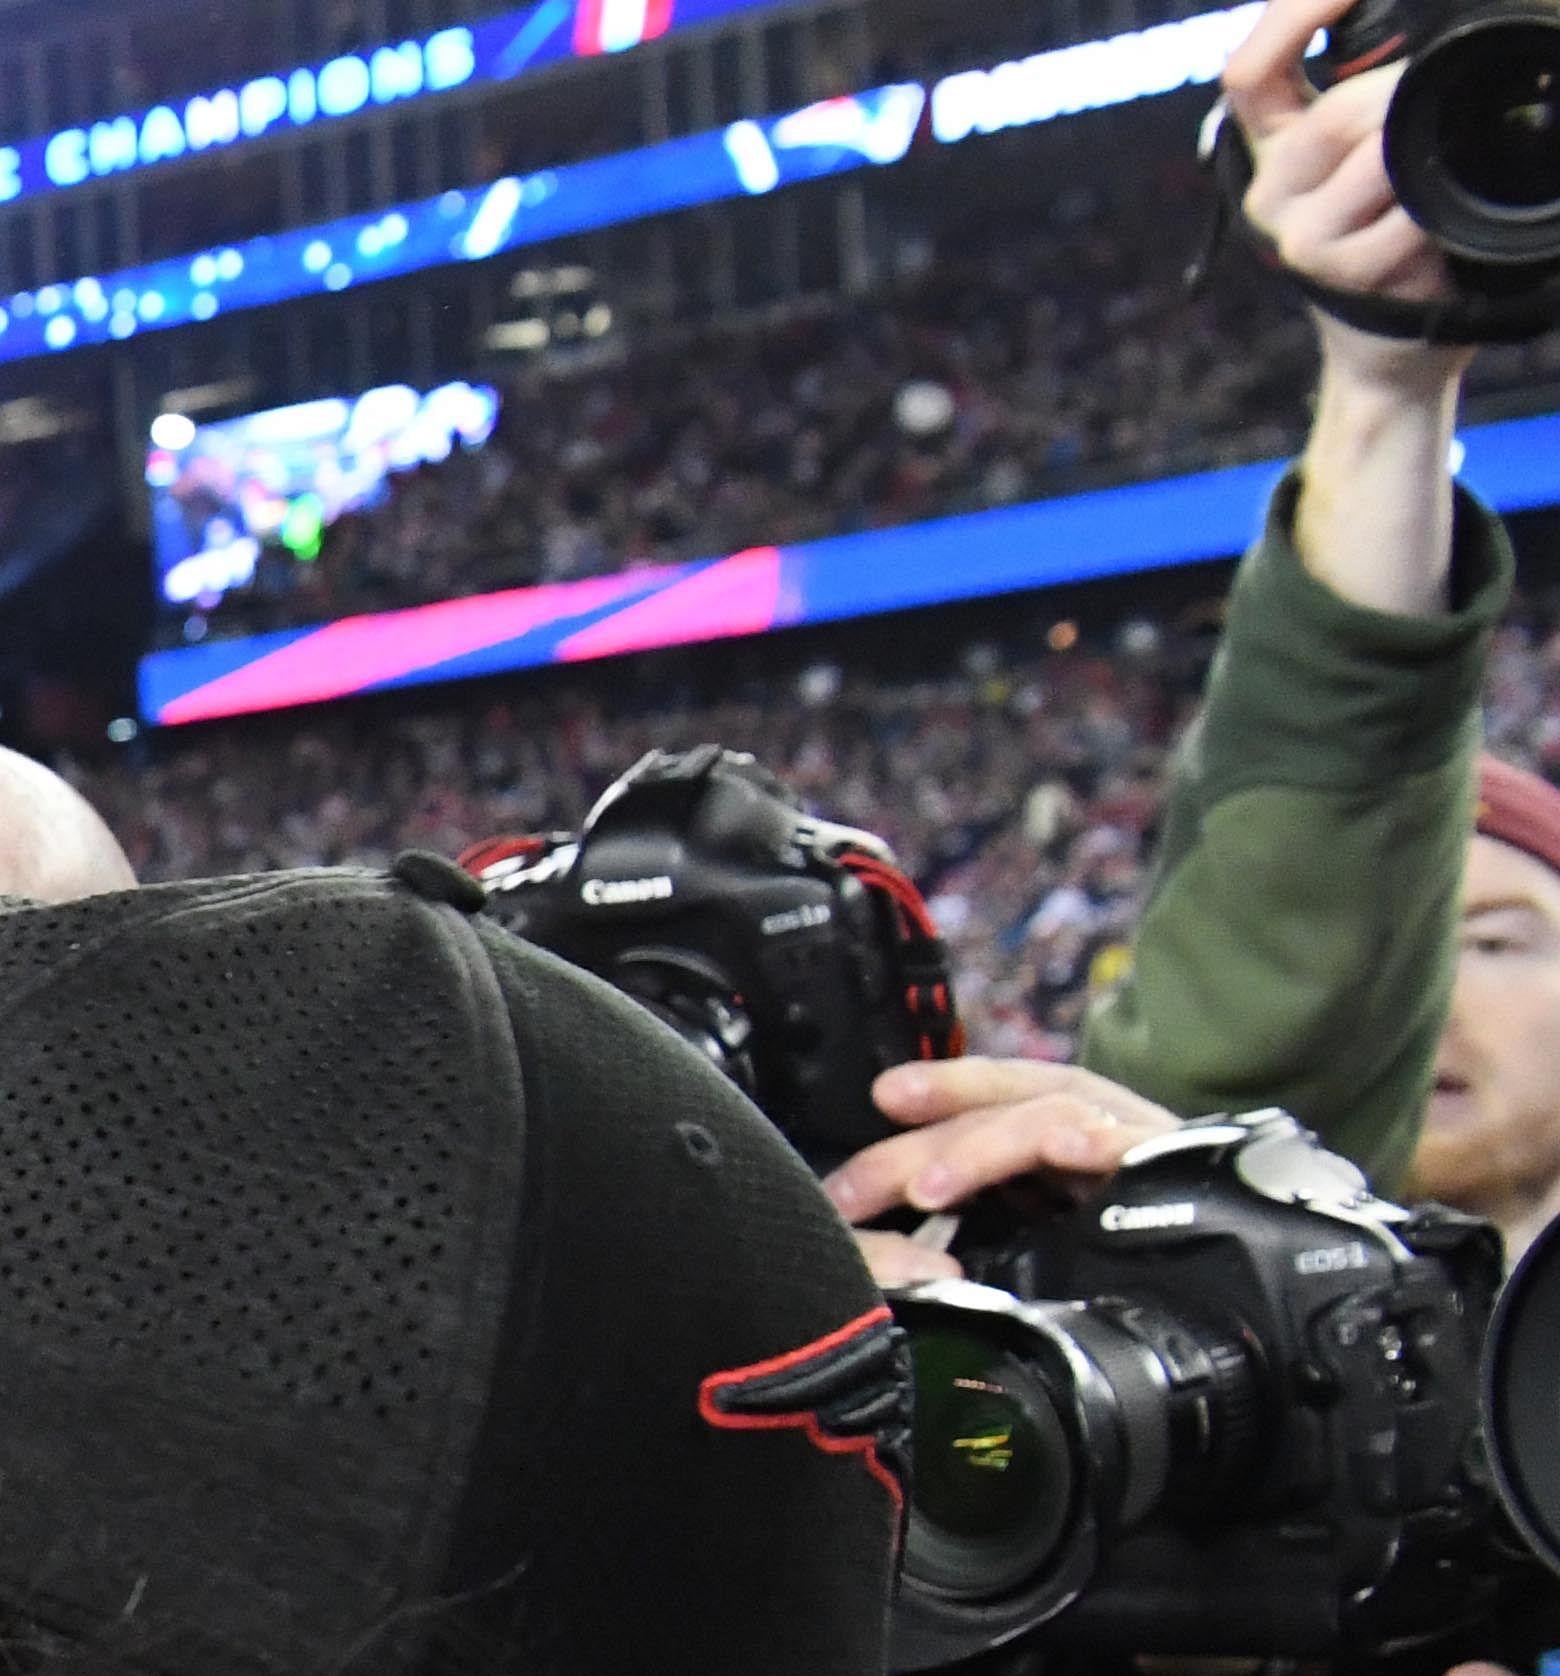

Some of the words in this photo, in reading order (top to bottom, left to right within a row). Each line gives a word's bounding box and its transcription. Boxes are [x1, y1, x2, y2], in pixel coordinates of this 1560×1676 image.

[45, 27, 474, 186] CHAMPIONS
[582, 876, 673, 905] Canon
[1099, 1203, 1194, 1231] Canon
